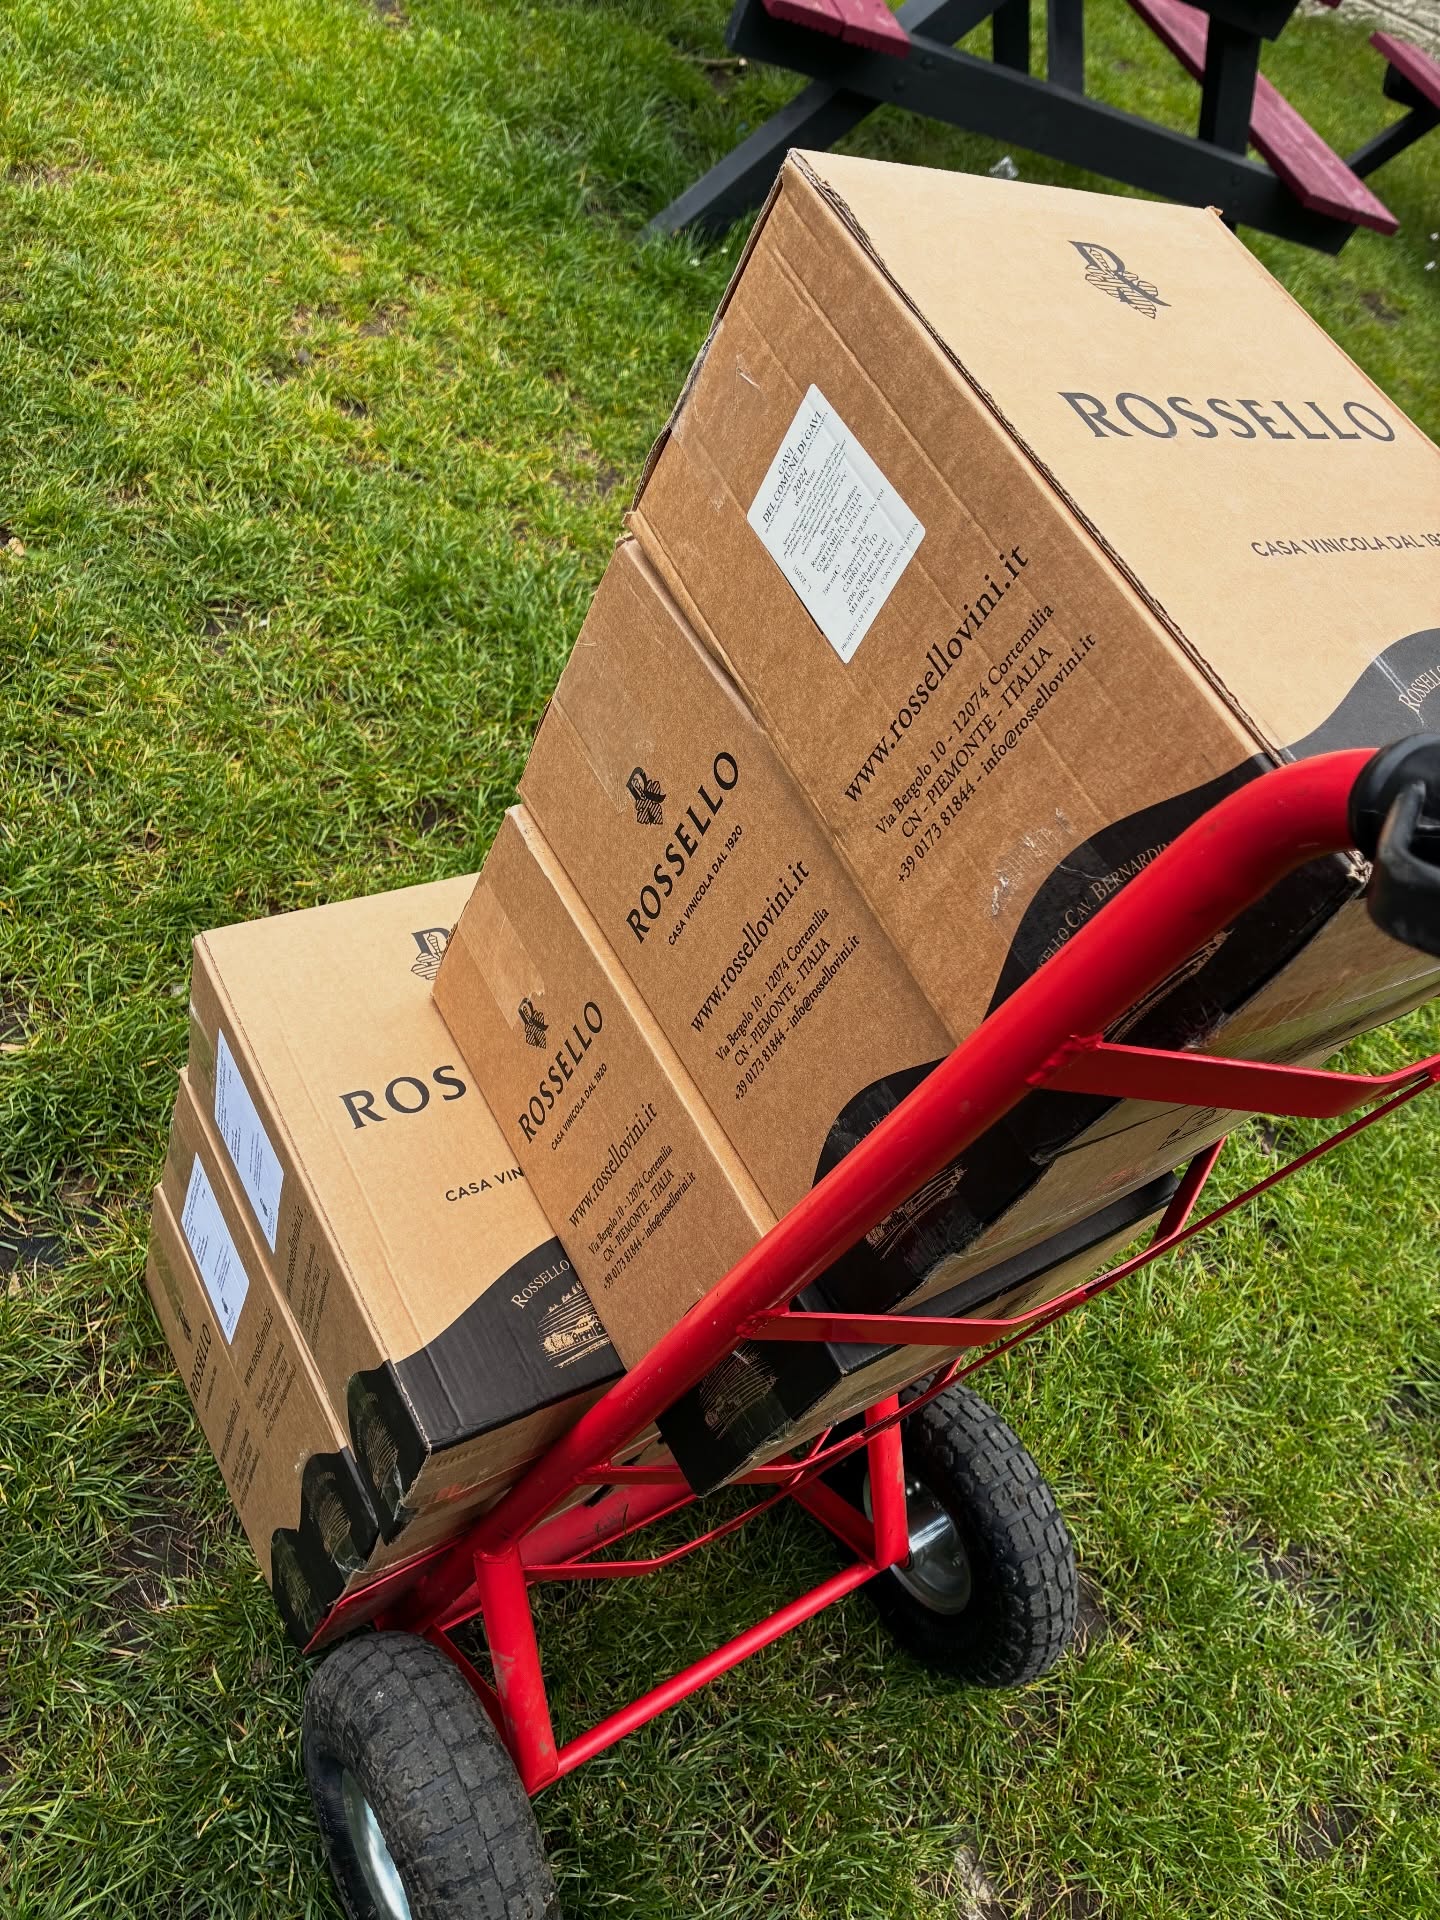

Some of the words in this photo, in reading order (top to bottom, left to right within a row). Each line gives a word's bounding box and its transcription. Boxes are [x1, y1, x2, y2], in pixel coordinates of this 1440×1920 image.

[762, 501, 777, 524] DEL
[773, 452, 800, 502] COMUNE
[796, 438, 807, 455] DI
[804, 410, 822, 440] GAVI
[777, 446, 794, 475] GAVI
[1056, 391, 1396, 442] ROSSELLO
[792, 466, 808, 497] 2024
[844, 493, 862, 520] ITALIA
[847, 504, 863, 528] ITALIA
[841, 543, 864, 581] Imported
[855, 559, 876, 591] Oldham
[872, 536, 888, 560] Road
[866, 541, 894, 585] Manchester
[1251, 540, 1307, 557] CASA
[1302, 537, 1390, 553] VINICOLA
[1386, 535, 1425, 549] DAL
[844, 545, 1029, 802] www.rossellovini.it
[875, 813, 897, 834] Via
[891, 764, 932, 815] Bergolo
[929, 740, 947, 764] 10
[952, 681, 991, 734] 12074
[987, 605, 1055, 686] Cortemilia
[898, 855, 916, 883] +39
[914, 822, 942, 859] 0173
[939, 778, 977, 827] 81844
[980, 634, 1096, 776] info@rossellovini.it
[901, 808, 923, 838] CN
[925, 713, 997, 807] PIEMONTE
[1000, 646, 1054, 710] ITALIA
[625, 751, 738, 944] ROSSELLO
[668, 919, 687, 946] CASA
[683, 873, 715, 920] VINICOLA
[711, 851, 729, 875] DAL
[724, 824, 743, 852] 1920
[690, 860, 810, 1033] www.rossellovini.it
[714, 1044, 731, 1061] Via
[726, 1011, 754, 1048] Bergolo
[750, 995, 763, 1013] 10
[764, 956, 790, 993] 12074
[786, 908, 830, 962] Cortemilia
[734, 1044, 750, 1067] CN
[749, 981, 797, 1045] PIEMONTE
[796, 937, 831, 981] ITALIA
[735, 1079, 748, 1101] +39
[745, 1057, 765, 1085] 0173
[761, 1027, 787, 1063] 81844
[787, 935, 860, 1029] info@rossellovini.it
[517, 1002, 603, 1143] ROSSELLO
[551, 1129, 566, 1151] CASA
[562, 1096, 587, 1132] VINICOLA
[583, 1081, 597, 1100] DAL
[593, 1062, 608, 1084] 1920
[445, 1179, 492, 1201] CASA
[568, 1102, 658, 1228] www.rossellovini.it
[587, 1241, 601, 1255] Via
[596, 1217, 618, 1245] Bergolo
[615, 1205, 625, 1221] 10
[625, 1177, 645, 1206] 12074
[641, 1145, 673, 1184] Cortemilia
[602, 1244, 615, 1262] CN
[614, 1199, 650, 1247] PIEMONTE
[649, 1168, 675, 1201] ITALIA
[511, 1260, 570, 1309] ROSSELLO
[603, 1273, 614, 1291] +39
[611, 1257, 627, 1279] 0173
[623, 1235, 643, 1263] 81844
[642, 1171, 696, 1239] info@rossellovini.it
[190, 1323, 212, 1400] ROSSELLO
